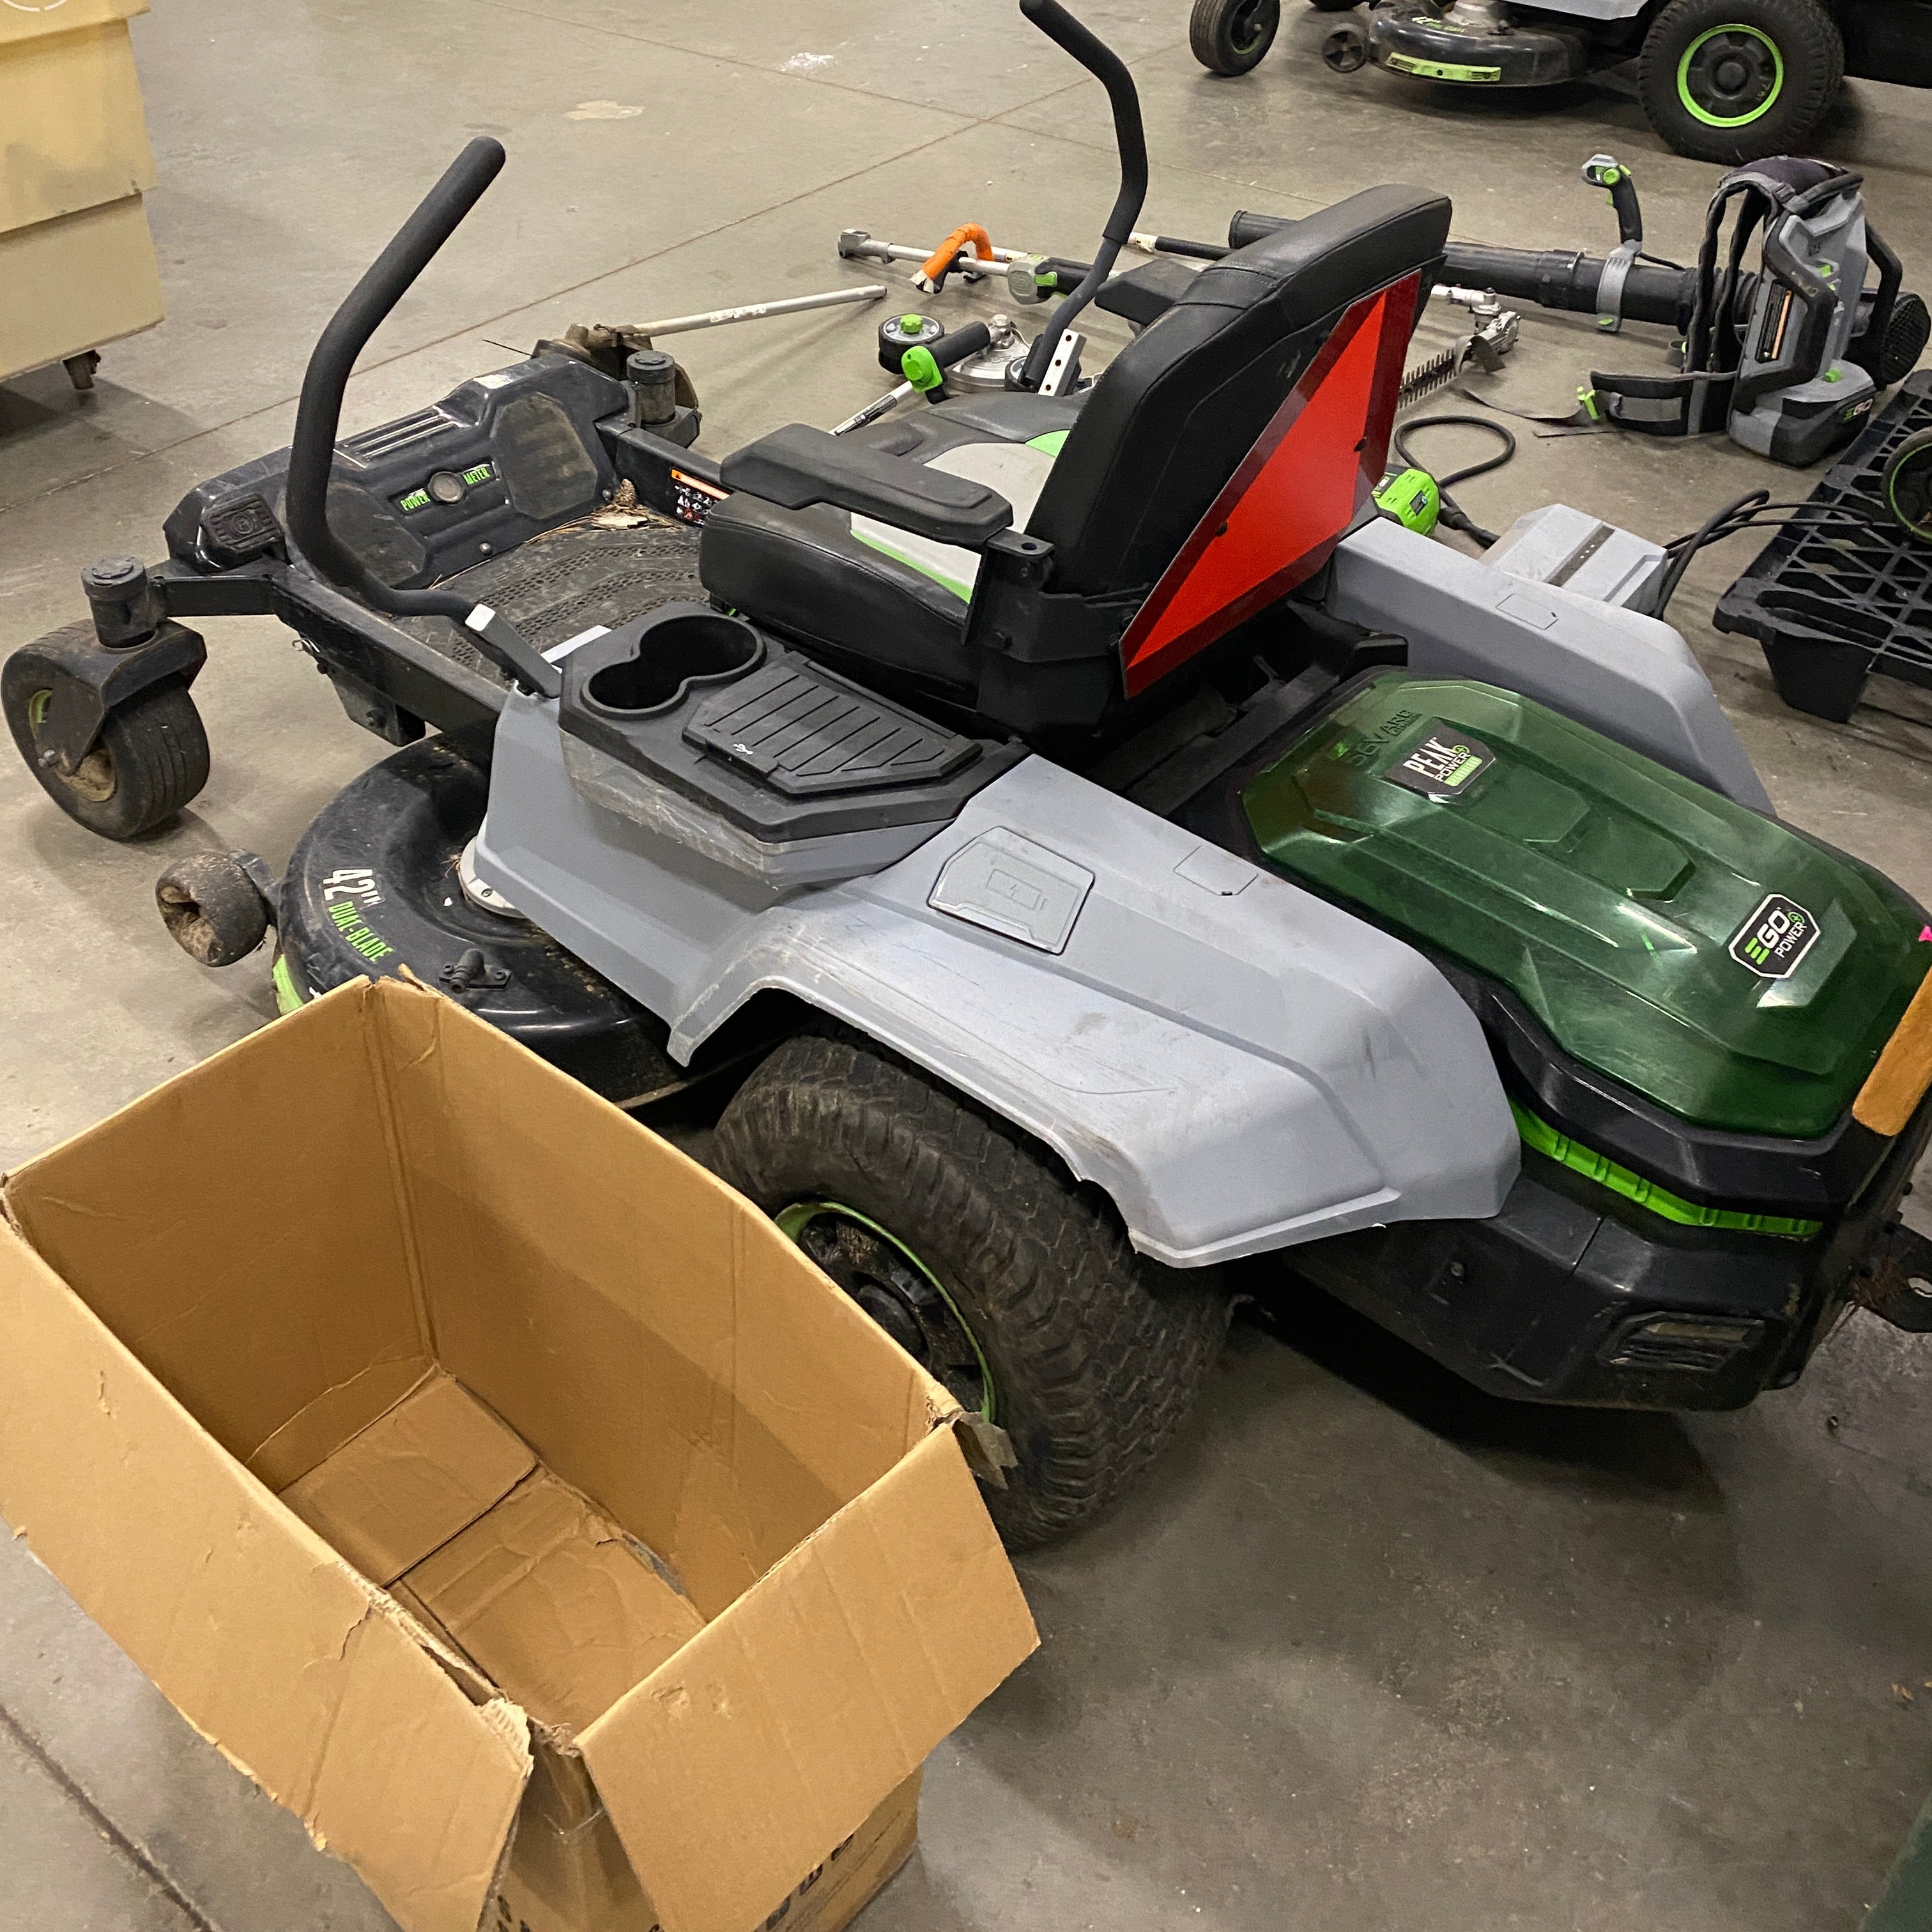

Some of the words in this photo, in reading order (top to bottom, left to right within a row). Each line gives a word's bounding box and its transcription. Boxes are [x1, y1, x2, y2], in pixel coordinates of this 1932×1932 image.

[400, 489, 431, 511] POWER
[463, 467, 490, 485] METER
[1403, 737, 1457, 778] PEAK
[1434, 751, 1471, 783] POWER
[328, 901, 394, 962] DUAL-BLADE
[1744, 910, 1790, 965] EGO
[1774, 922, 1807, 958] POWER
